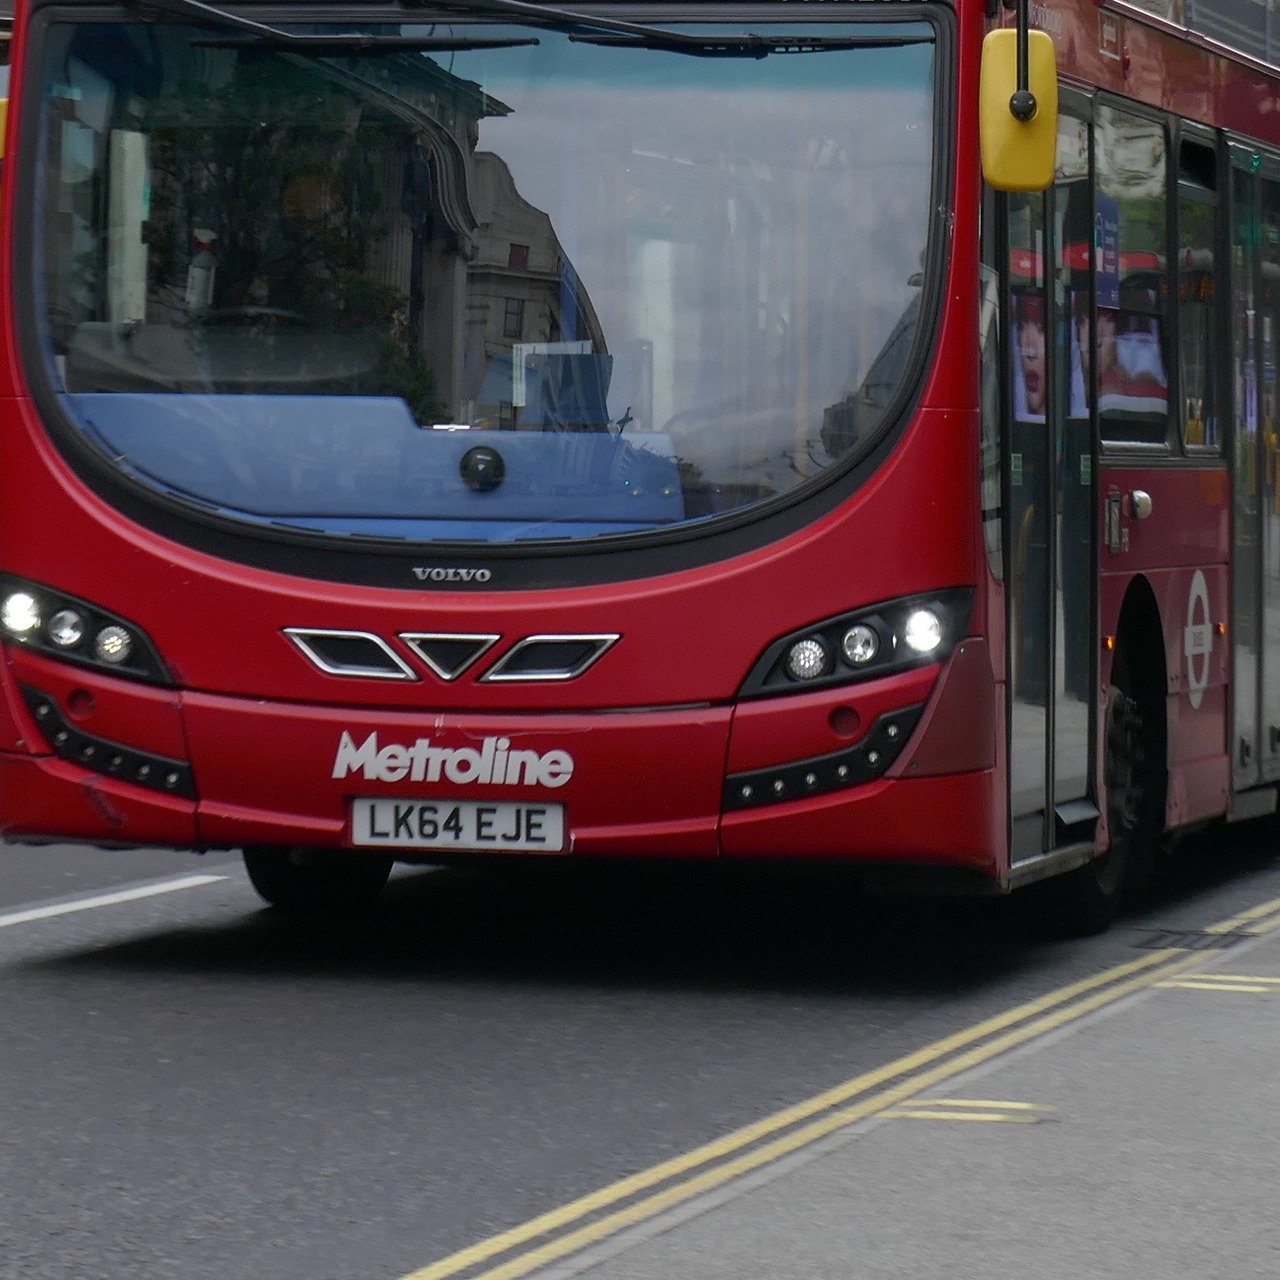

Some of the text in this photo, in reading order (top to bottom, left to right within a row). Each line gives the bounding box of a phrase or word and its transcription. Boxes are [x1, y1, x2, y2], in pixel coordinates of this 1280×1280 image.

[412, 567, 492, 583] VOLVO
[331, 730, 575, 789] Metroline
[368, 804, 547, 843] LK64 EJE
